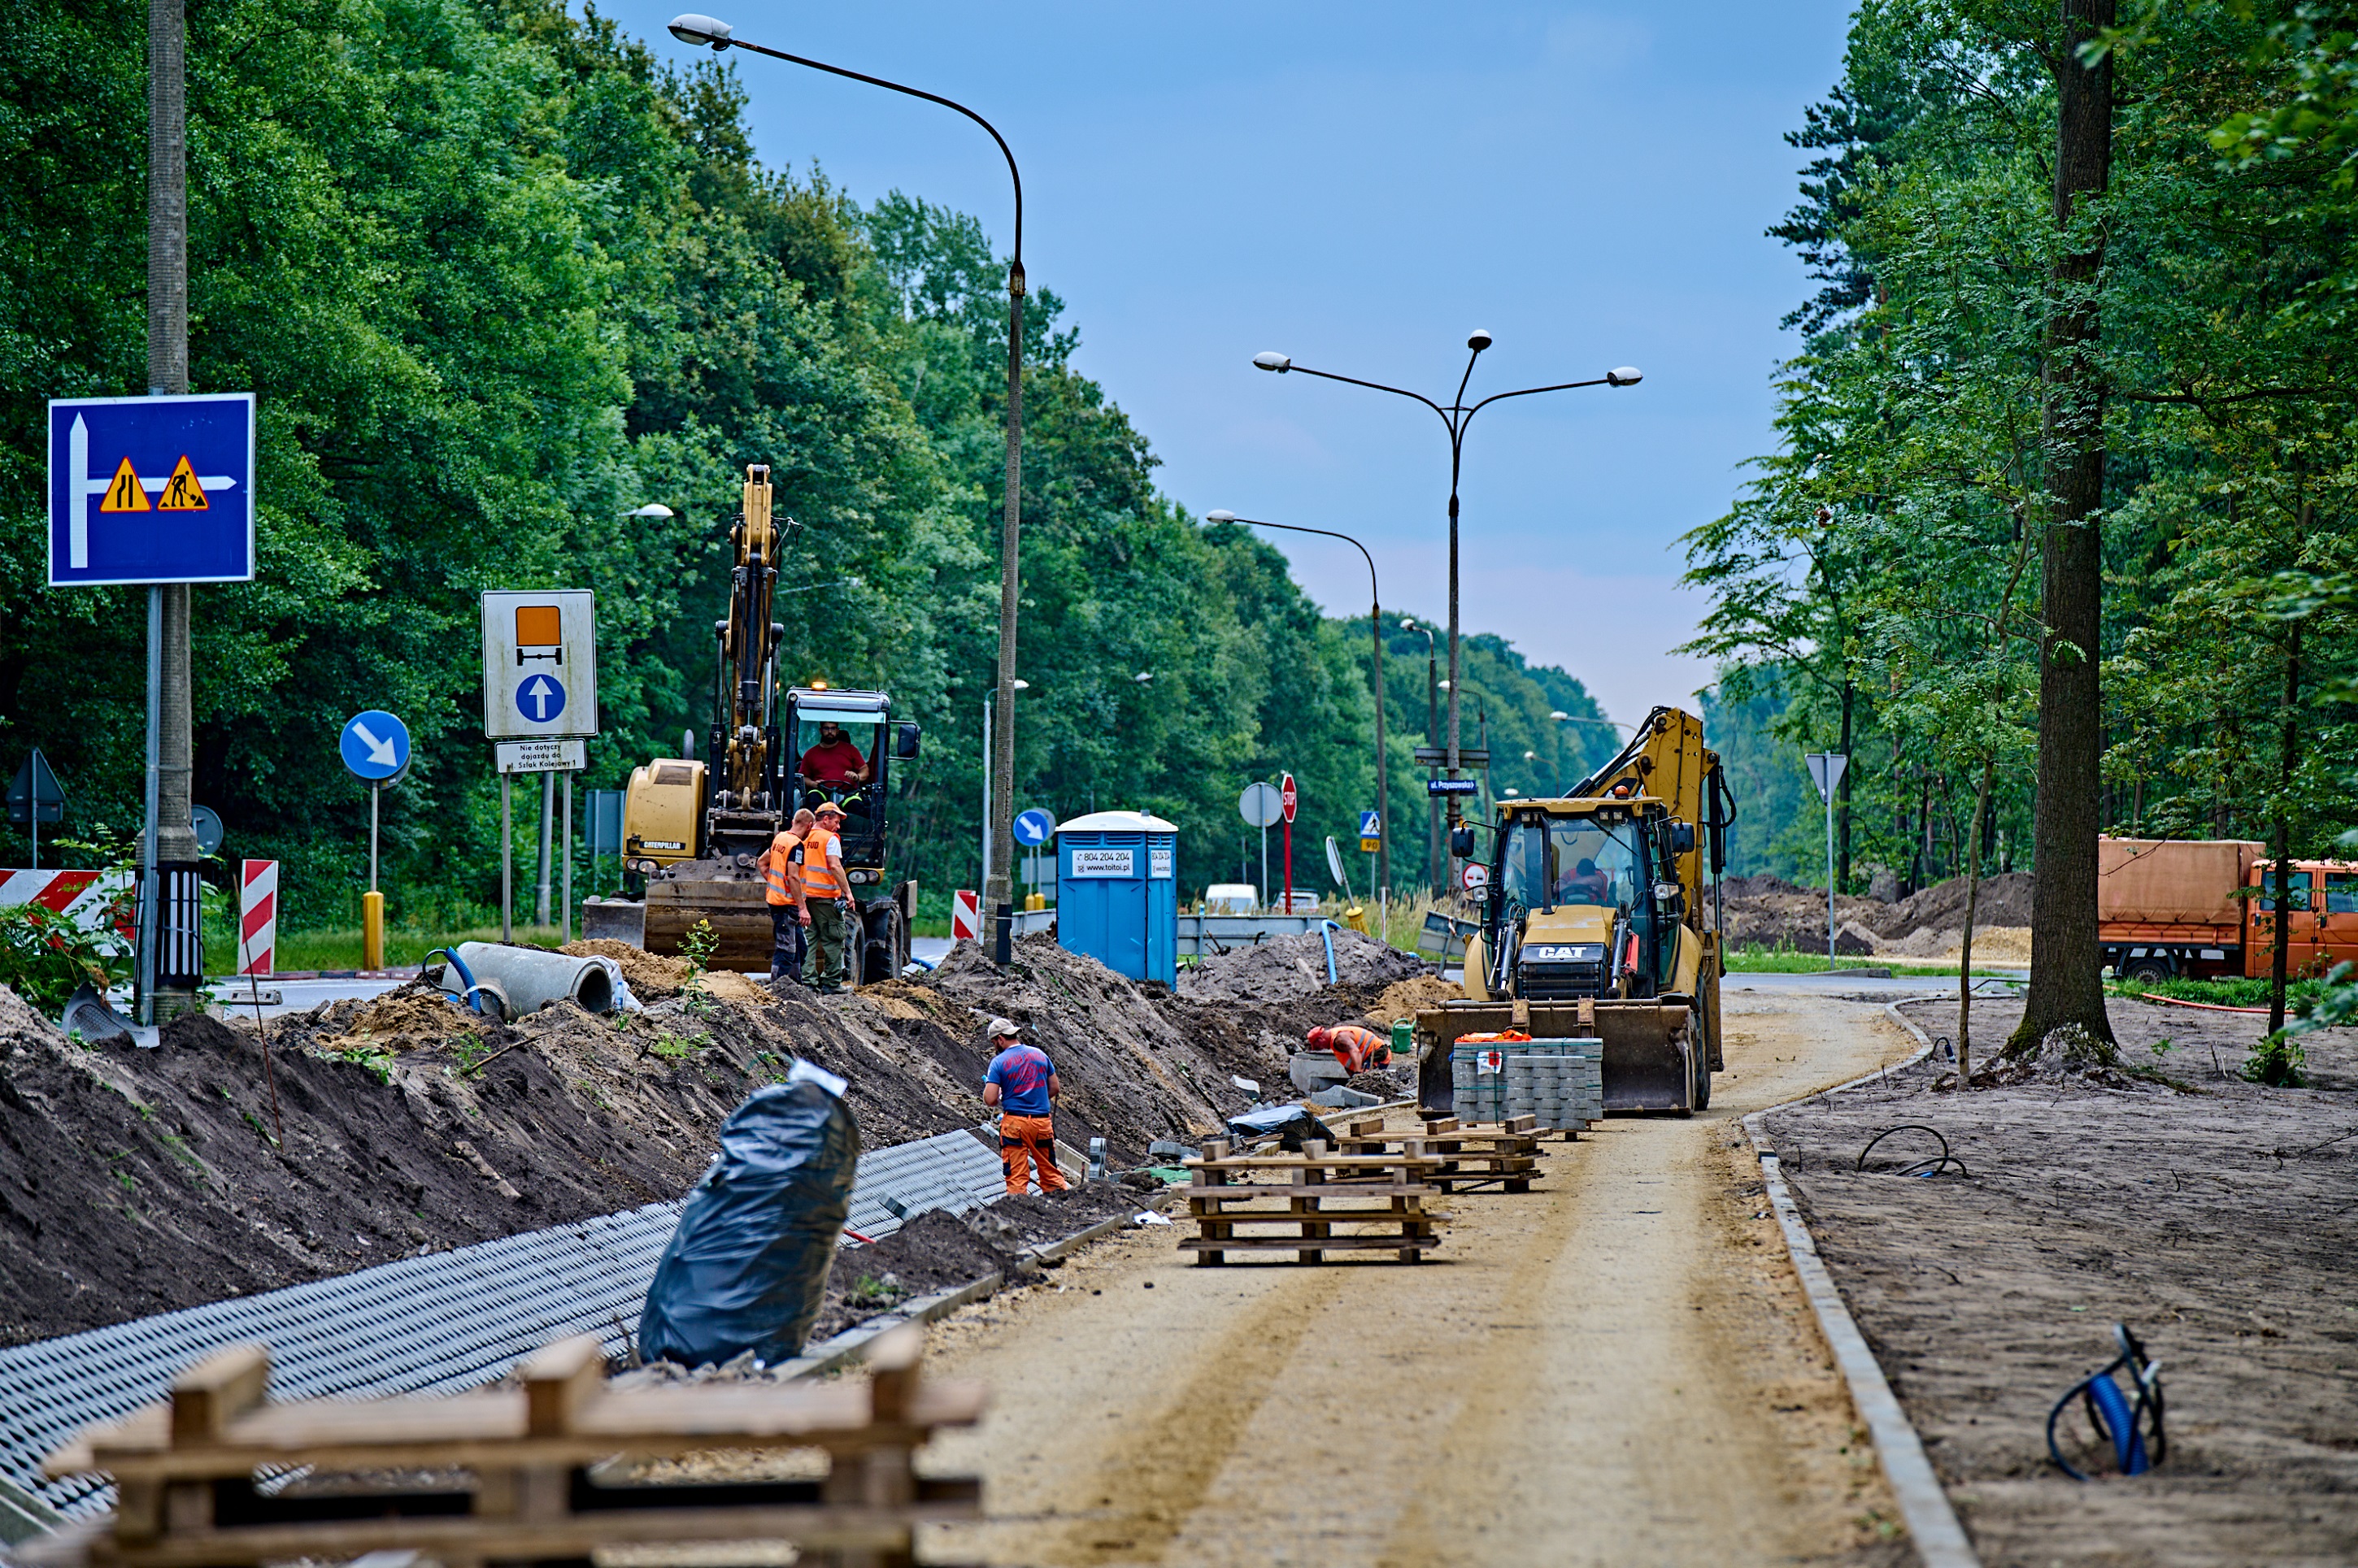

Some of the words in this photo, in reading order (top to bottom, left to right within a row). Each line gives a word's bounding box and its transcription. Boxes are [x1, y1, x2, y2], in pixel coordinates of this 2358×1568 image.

[1284, 791, 1295, 806] STOP
[643, 841, 681, 849] CATERPILLAR
[1084, 852, 1098, 862] 804
[1099, 852, 1114, 862] 204
[1116, 852, 1129, 861] 204
[1086, 863, 1130, 872] www.toitoi.pl
[1538, 946, 1587, 959] CAT
